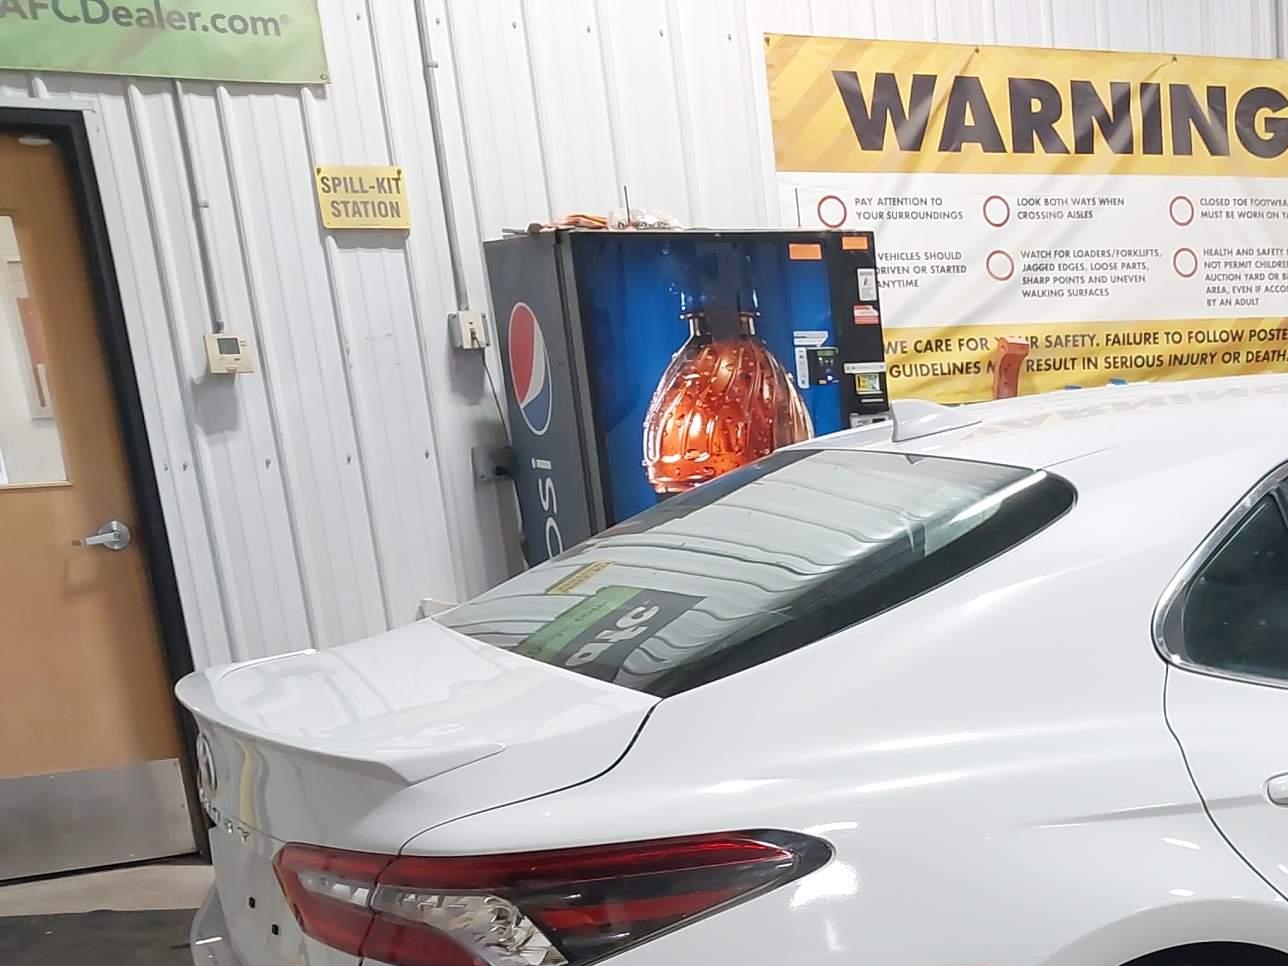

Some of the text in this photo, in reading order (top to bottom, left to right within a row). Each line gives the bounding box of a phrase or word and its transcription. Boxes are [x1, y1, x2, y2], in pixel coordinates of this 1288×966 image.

[320, 176, 401, 194] SPILL-KIT
[855, 197, 943, 206] PAY ATTENTION TO
[1017, 197, 1125, 206] LOOK BOTH WAYS WHEN
[1200, 198, 1231, 206] CLOSED
[1233, 198, 1248, 206] TOE
[330, 200, 401, 218] STATION
[856, 211, 963, 220] YOUR SURROUNDINGS
[1017, 210, 1093, 219] CROSSING AISLES
[1201, 211, 1223, 219] MUST
[1225, 211, 1235, 219] BE
[1237, 211, 1264, 219] WORN
[1267, 211, 1279, 219] ON
[878, 251, 962, 261] VEHICLES SHOULD
[1021, 249, 1162, 259] WATCH FOR LOADERS/FORKLIFTS,
[1203, 248, 1233, 256] HEALTH
[1235, 248, 1254, 256] AND
[1256, 248, 1284, 256] SAFETY
[875, 265, 967, 274] DRIVEN OR STARTED
[1022, 262, 1150, 273] JAGGED EDGES, LOOSE PARTS,
[1204, 261, 1222, 269] NOT
[1224, 261, 1252, 269] PERMIT
[1022, 275, 1145, 285] SHARP POINTS AND UNEVEN
[1205, 273, 1241, 281] AUCTION
[1244, 273, 1265, 281] YARD
[1268, 273, 1279, 281] OR
[877, 279, 919, 288] ANYTIME
[1022, 288, 1110, 298] WALKING SURFACES
[1206, 286, 1230, 295] AREA,
[1232, 286, 1252, 294] EVEN
[1207, 299, 1216, 307] BY
[1235, 298, 1259, 306] ADULT
[884, 340, 908, 354] WE
[913, 338, 952, 354] CARE
[958, 336, 990, 352] FOR
[1044, 333, 1100, 349] SAFETY.
[1105, 331, 1159, 347] FAILURE
[1164, 331, 1183, 345] TO
[1188, 329, 1244, 344] FOLLOW
[889, 361, 981, 378] GUIDELINES
[1026, 357, 1076, 373] RESULT
[1082, 356, 1098, 370] IN
[1104, 354, 1164, 370] SERIOUS
[1168, 352, 1217, 366] INJURY
[1221, 351, 1241, 365] OR
